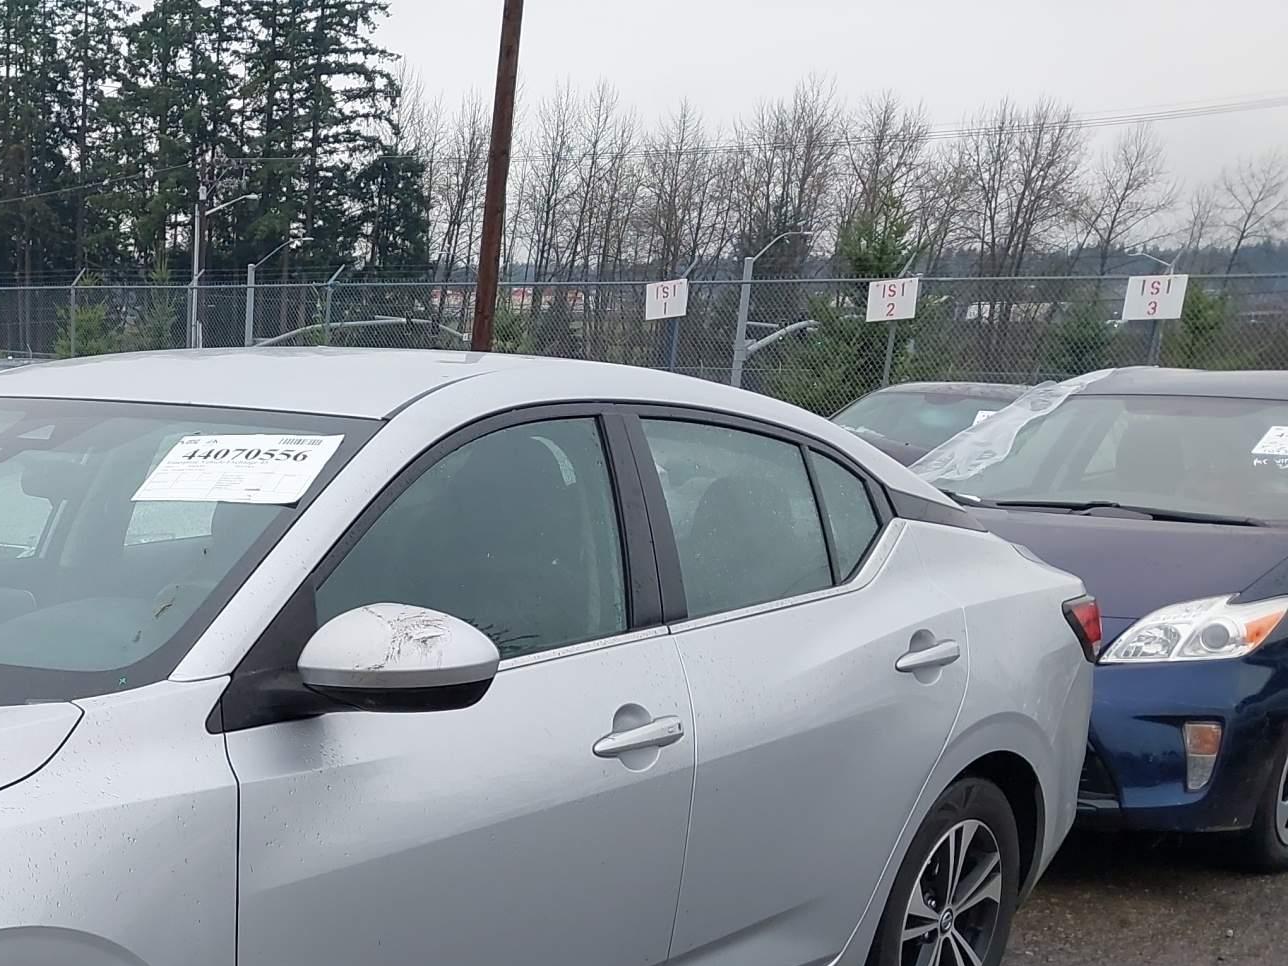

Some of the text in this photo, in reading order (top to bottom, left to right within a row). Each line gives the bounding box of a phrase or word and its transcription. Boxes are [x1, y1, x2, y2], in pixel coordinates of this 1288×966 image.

[885, 302, 896, 317] 2
[1146, 300, 1158, 316] 3
[181, 447, 313, 463] 44070556
